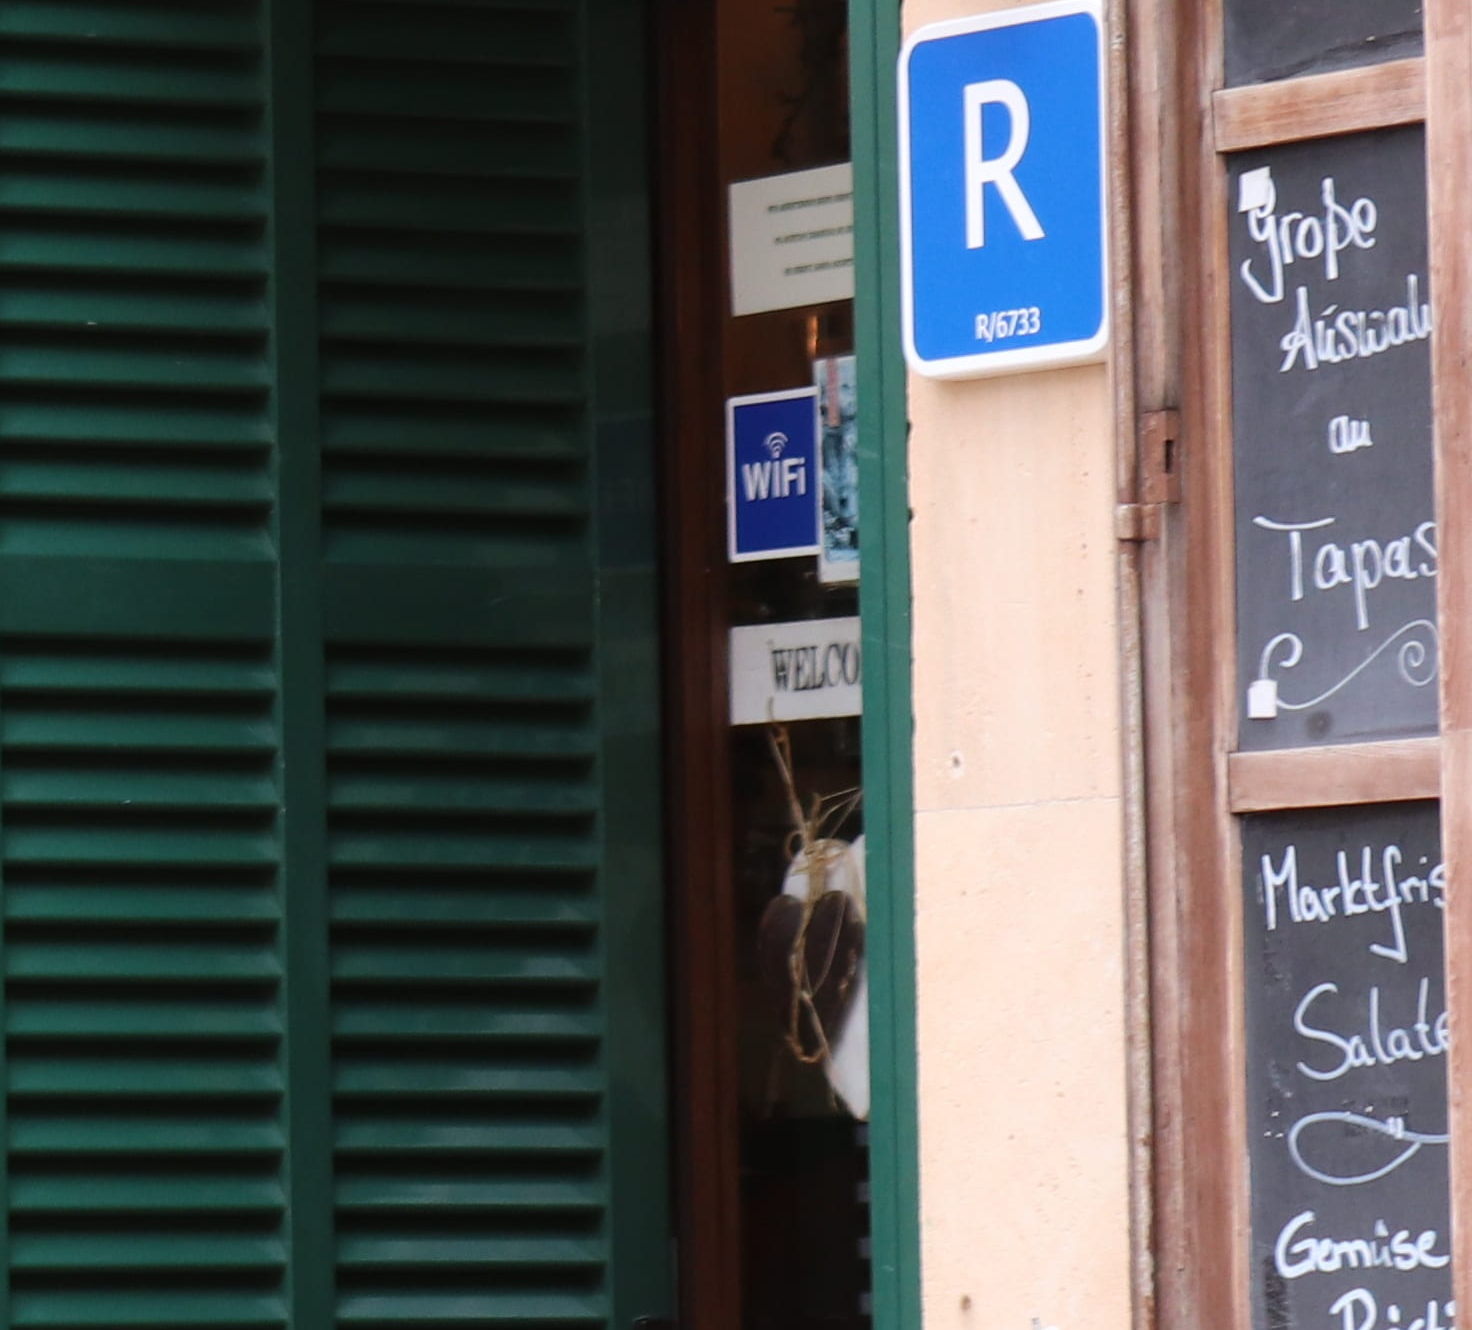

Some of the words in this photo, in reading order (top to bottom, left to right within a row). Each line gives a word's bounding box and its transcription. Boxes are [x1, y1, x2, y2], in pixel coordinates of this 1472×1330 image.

[963, 77, 1047, 251] R
[975, 306, 1042, 344] R/6733
[1252, 515, 1440, 631] Tapas
[771, 642, 861, 692] WELCO
[1273, 1209, 1451, 1279] Gemüse
